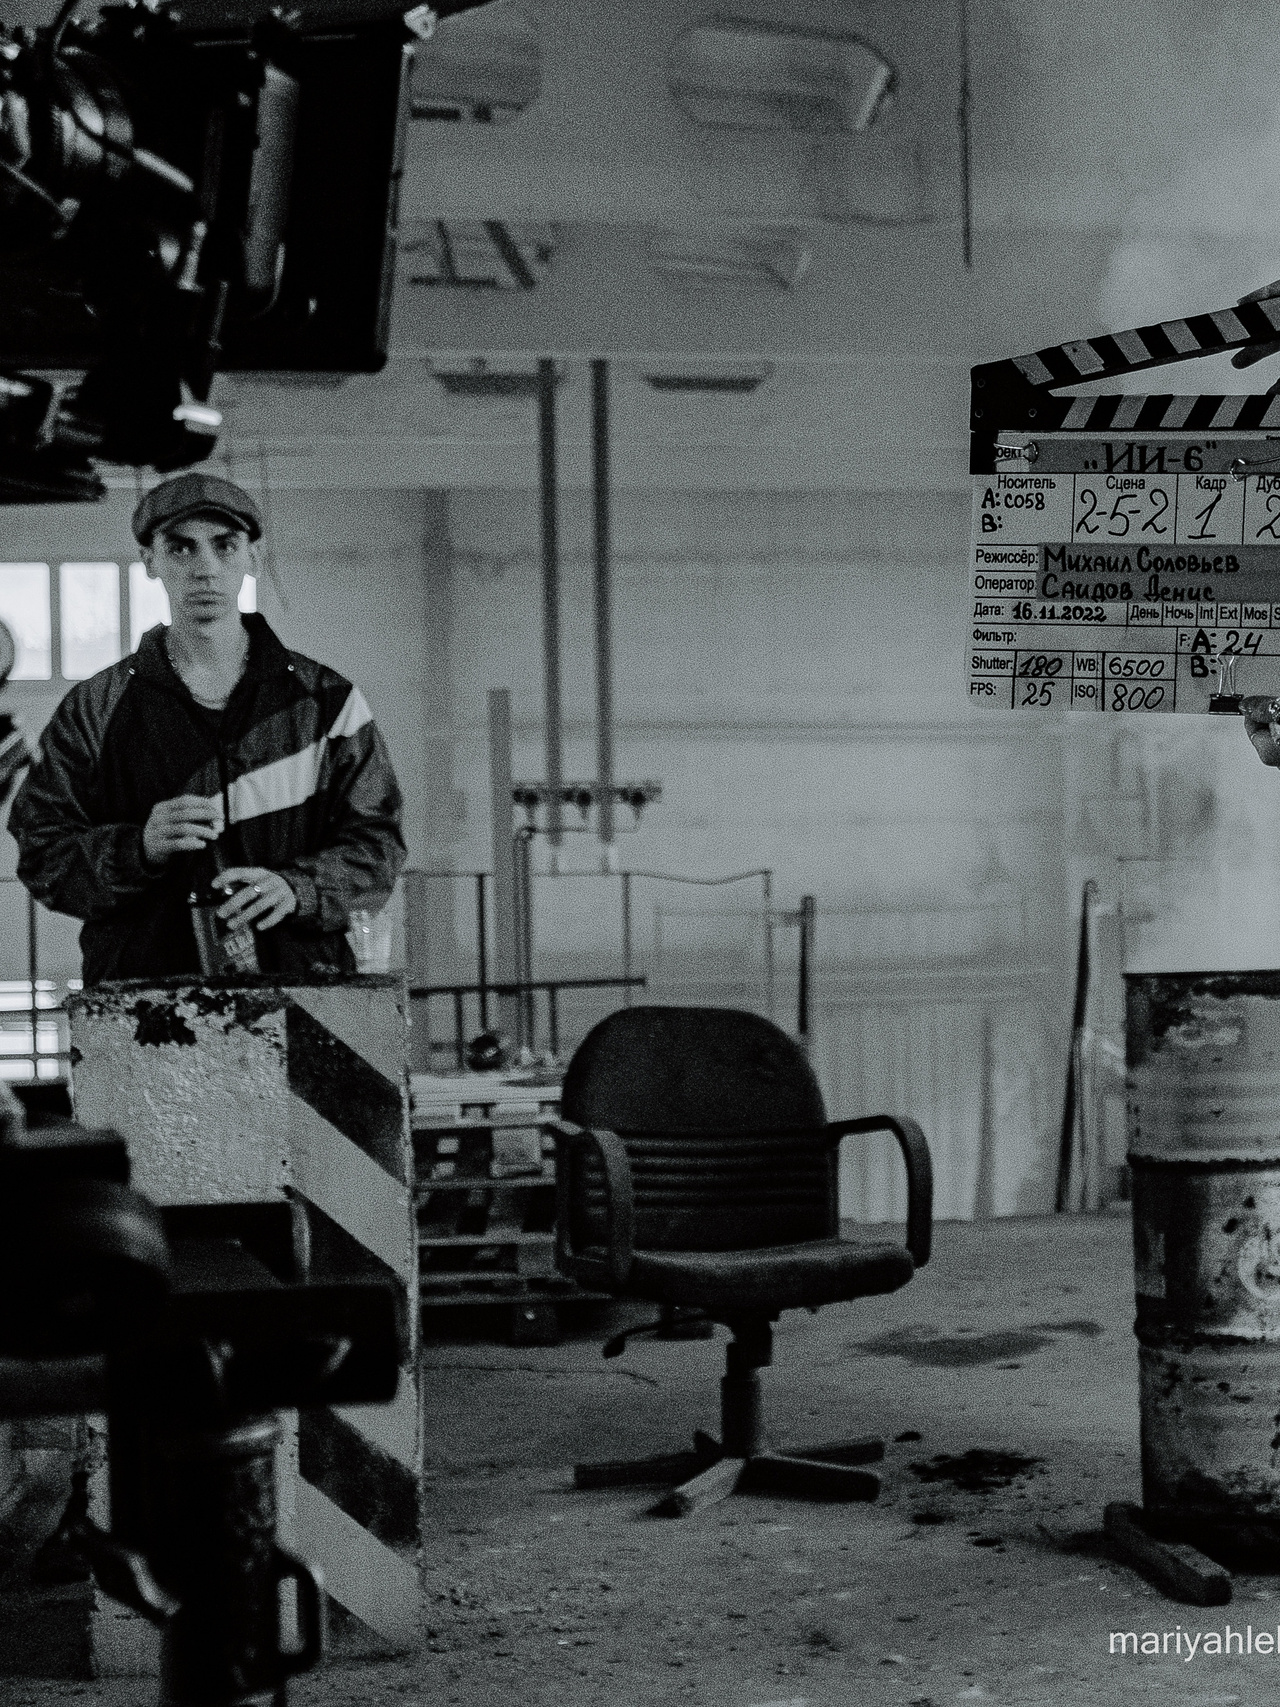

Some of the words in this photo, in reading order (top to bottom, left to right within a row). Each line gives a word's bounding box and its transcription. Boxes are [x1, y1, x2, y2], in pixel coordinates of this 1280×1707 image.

[997, 475, 1057, 489] Носитель
[1105, 475, 1146, 493] Сцена
[1196, 476, 1227, 494] Кадр
[1075, 488, 1169, 537] 2-5-2
[1187, 493, 1224, 540] 1
[975, 549, 1039, 567] Режиссёр:
[1043, 545, 1132, 573] Михаил
[1137, 546, 1240, 573] Соловьев
[1042, 573, 1133, 602] Саидов
[1143, 574, 1216, 602] Денис
[973, 603, 1005, 617] Дата:
[1011, 605, 1107, 622] 16.11.2022
[1130, 607, 1160, 621] День
[1164, 608, 1195, 620] Ночь
[1199, 608, 1214, 620] Int
[1219, 608, 1238, 620] Ext
[1244, 608, 1268, 621] Mos
[972, 628, 1017, 644] Фильтр:
[1179, 634, 1190, 647] F:
[1219, 630, 1263, 656] 24
[971, 656, 1014, 670] Shutter:
[1018, 655, 1063, 677] 180
[1076, 658, 1099, 672] WB:
[1108, 658, 1165, 678] 6500
[970, 682, 997, 696] FPS:
[1022, 682, 1056, 706] 25
[1075, 684, 1099, 698] ISO:
[1112, 683, 1165, 712] 800
